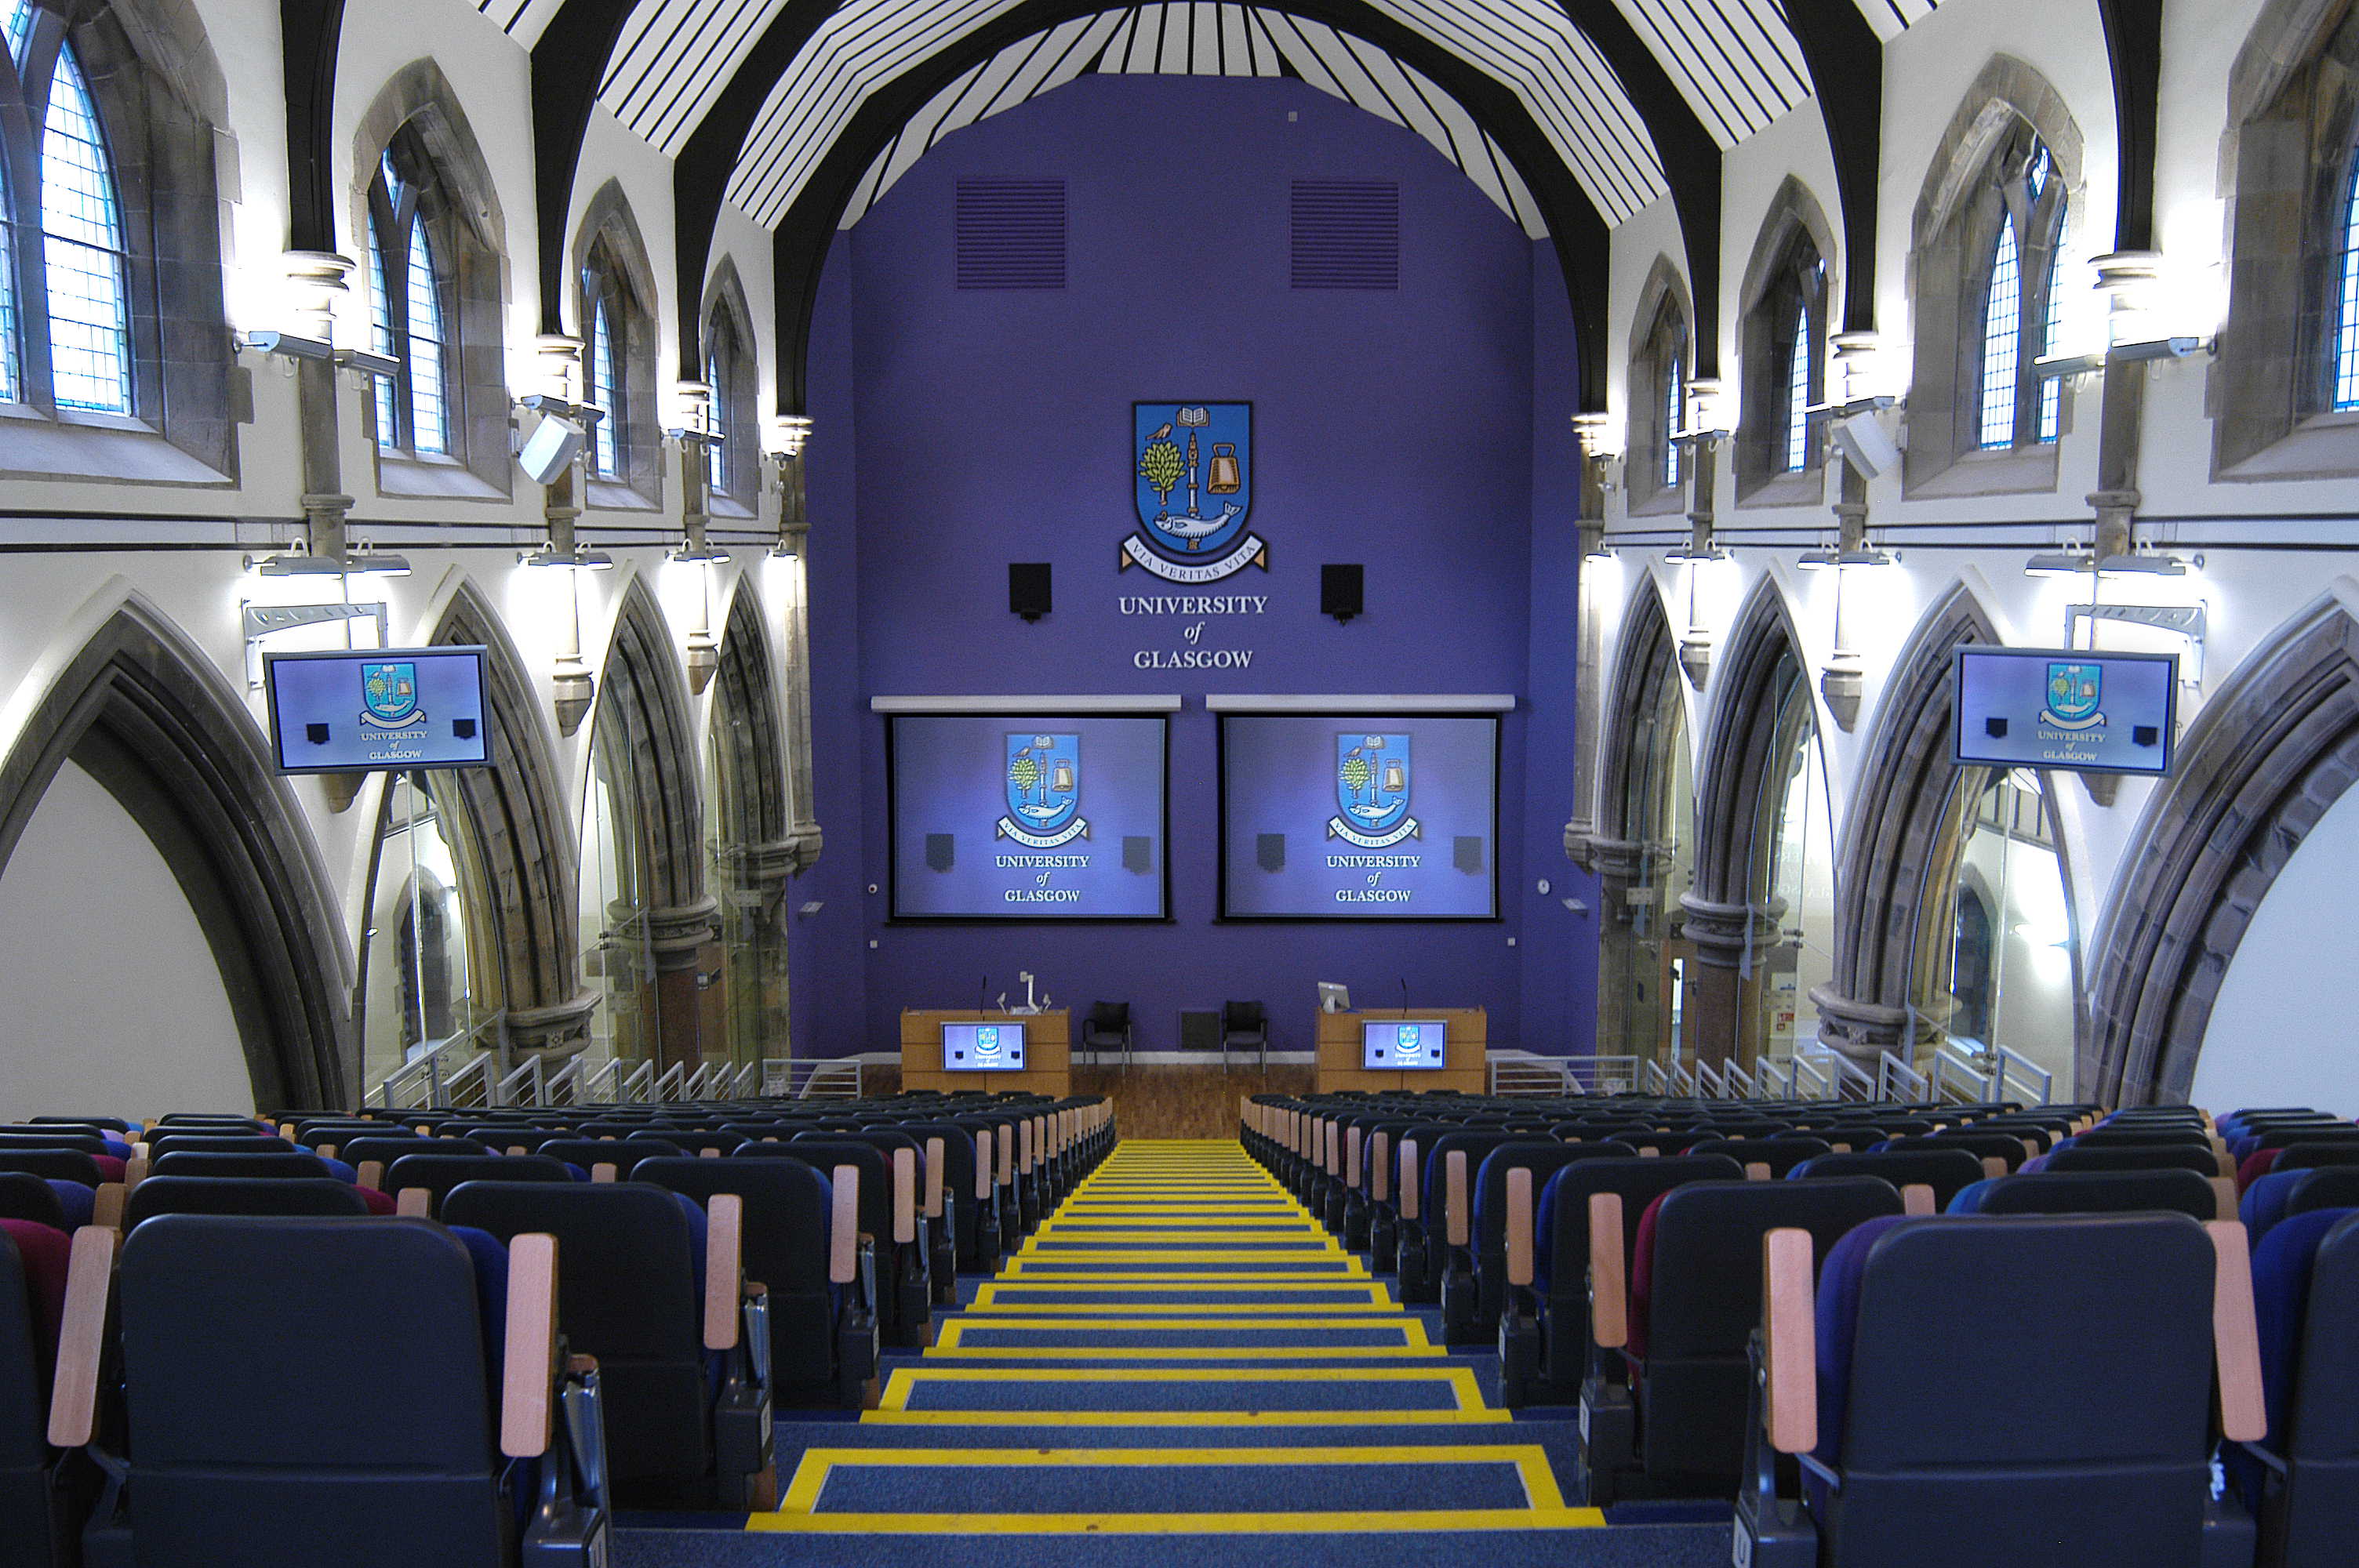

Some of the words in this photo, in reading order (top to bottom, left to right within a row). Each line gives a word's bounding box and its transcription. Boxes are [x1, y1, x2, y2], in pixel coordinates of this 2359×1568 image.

[1133, 543, 1154, 568] VIA
[1160, 563, 1220, 581] VERITAS
[1224, 546, 1256, 571] VITA
[1119, 596, 1267, 615] UNIVERSITY
[1184, 621, 1205, 645] of
[1134, 650, 1253, 670] GLASGOW
[361, 731, 427, 740] UNIVERSITY
[2037, 731, 2106, 742] UNIVERSITY
[369, 750, 422, 760] GLASGOW
[2043, 750, 2097, 761] GLASGOW
[1005, 822, 1017, 837] VIA
[1022, 835, 1059, 844] VERITAS
[1062, 824, 1081, 839] VITA
[1336, 822, 1348, 837] VIA
[1353, 835, 1390, 844] VERITAS
[995, 855, 1089, 867] UNIVERSITY
[1326, 855, 1420, 867] UNIVERSITY
[1036, 871, 1051, 887] of
[1367, 871, 1382, 887] of
[1005, 890, 1079, 902] GLASGOW
[1336, 890, 1411, 902] GLASGOW
